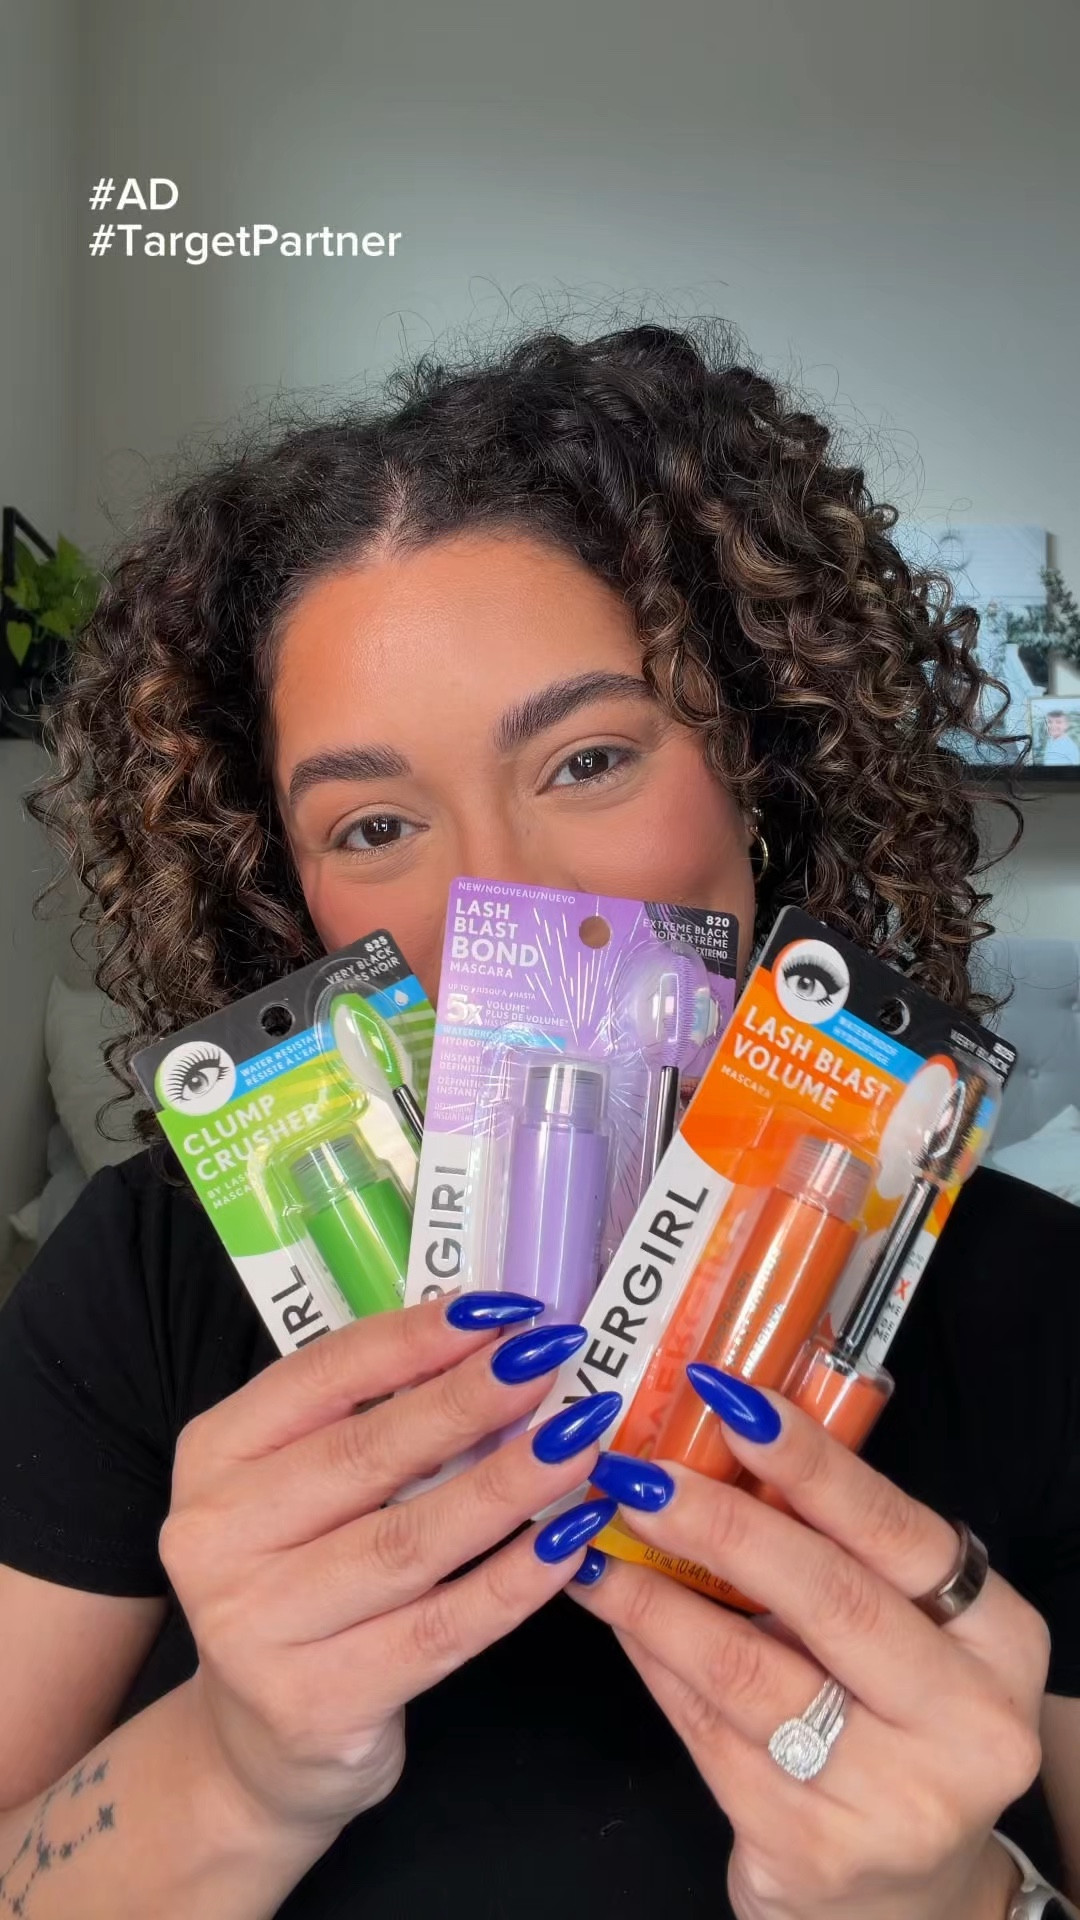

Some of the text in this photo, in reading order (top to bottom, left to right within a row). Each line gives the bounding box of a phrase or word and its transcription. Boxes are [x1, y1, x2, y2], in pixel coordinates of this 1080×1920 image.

[458, 882, 576, 904] NEW/NOUVEAU/NUEVO
[456, 898, 510, 919] LASH
[454, 916, 519, 939] BLAST
[643, 918, 729, 939] EXTREME BLACK
[706, 915, 730, 928] 820
[364, 935, 388, 952] 825
[650, 930, 677, 941] NOIR
[452, 936, 539, 967] BOND
[326, 946, 394, 985] VERY BLACK
[369, 957, 400, 977] NOIR
[450, 961, 513, 979] MASCARA
[485, 1009, 509, 1020] PLUS
[511, 1013, 524, 1022] DE
[744, 1005, 814, 1062] LASH
[814, 1047, 893, 1106] BLAST
[240, 1056, 273, 1077] WATER
[733, 1033, 840, 1112] VOLUME
[721, 1065, 771, 1099] MASCARA
[184, 1094, 275, 1155] CLUMP
[196, 1103, 322, 1181] CRUSHER
